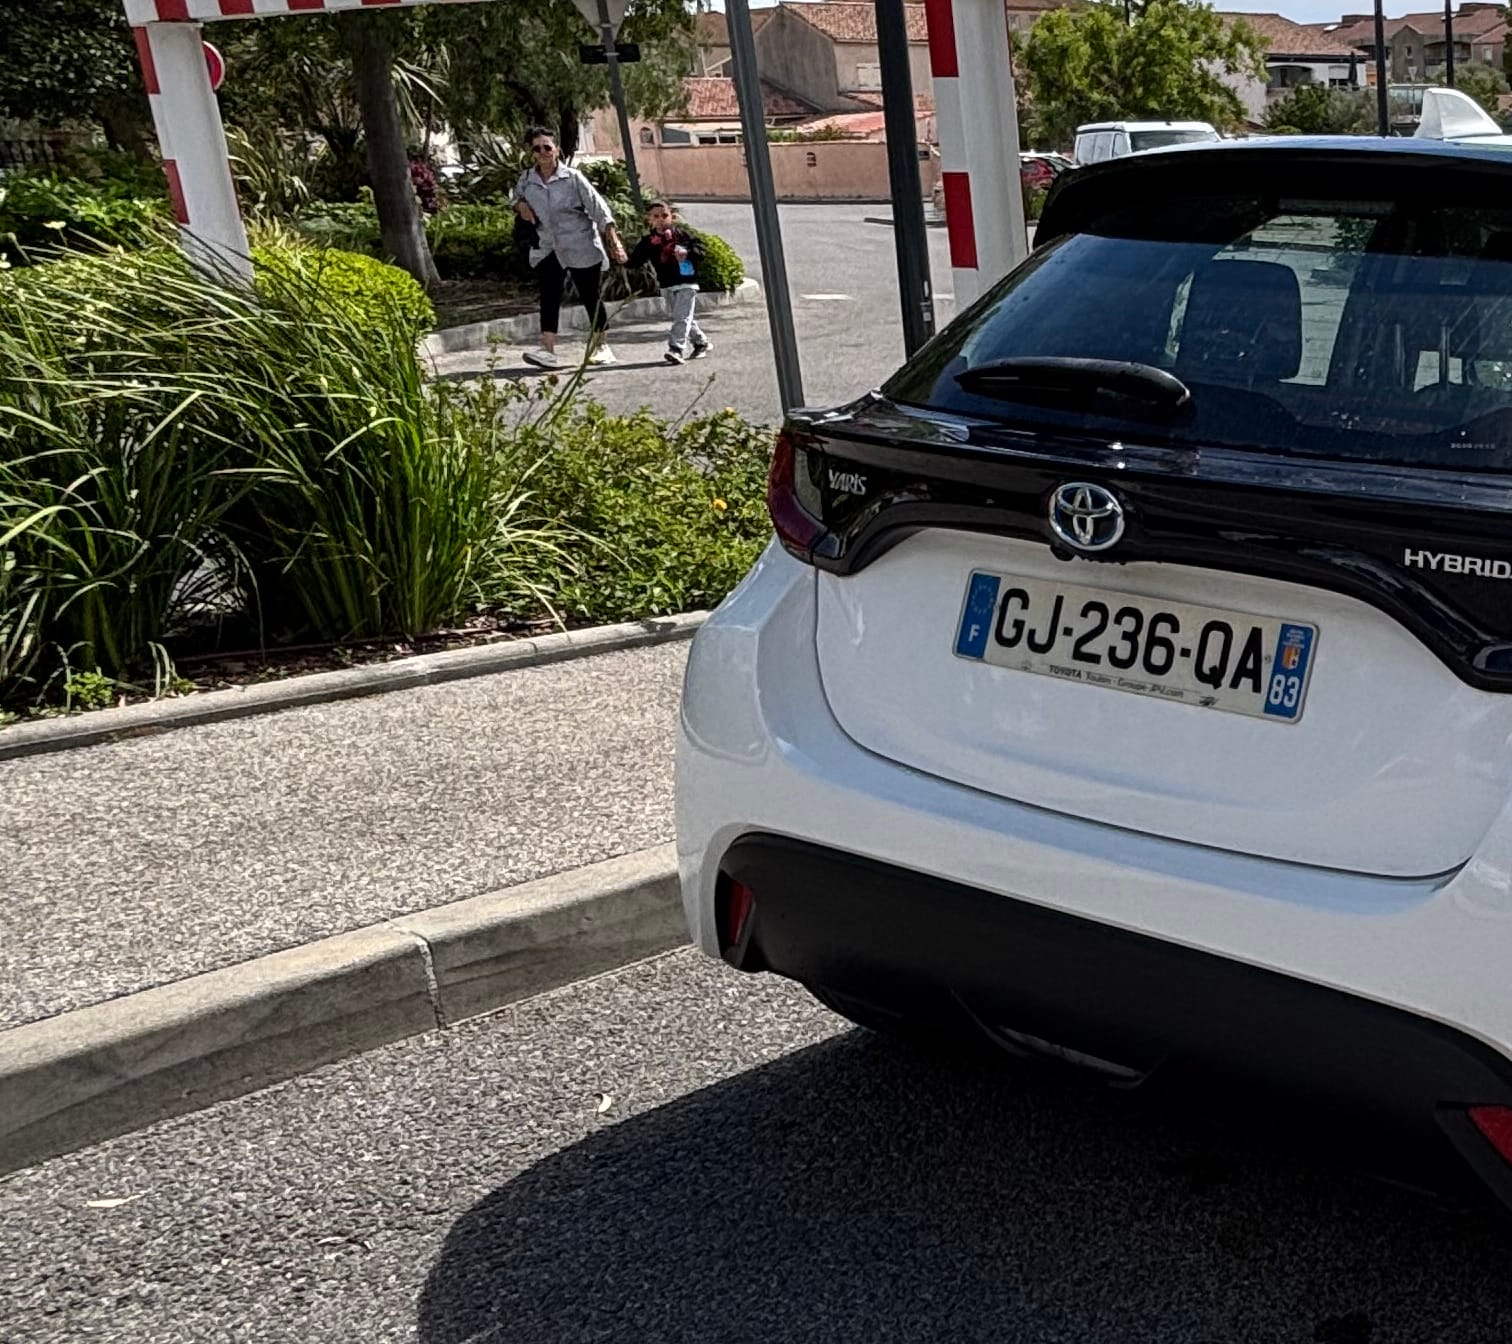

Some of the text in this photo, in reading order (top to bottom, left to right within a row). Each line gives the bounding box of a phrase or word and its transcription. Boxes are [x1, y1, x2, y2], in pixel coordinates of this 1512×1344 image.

[828, 469, 867, 495] YARIS
[1404, 548, 1512, 579] HYBRID
[968, 623, 981, 642] F
[994, 587, 1263, 694] GJ-236-QA
[1269, 673, 1301, 708] 83
